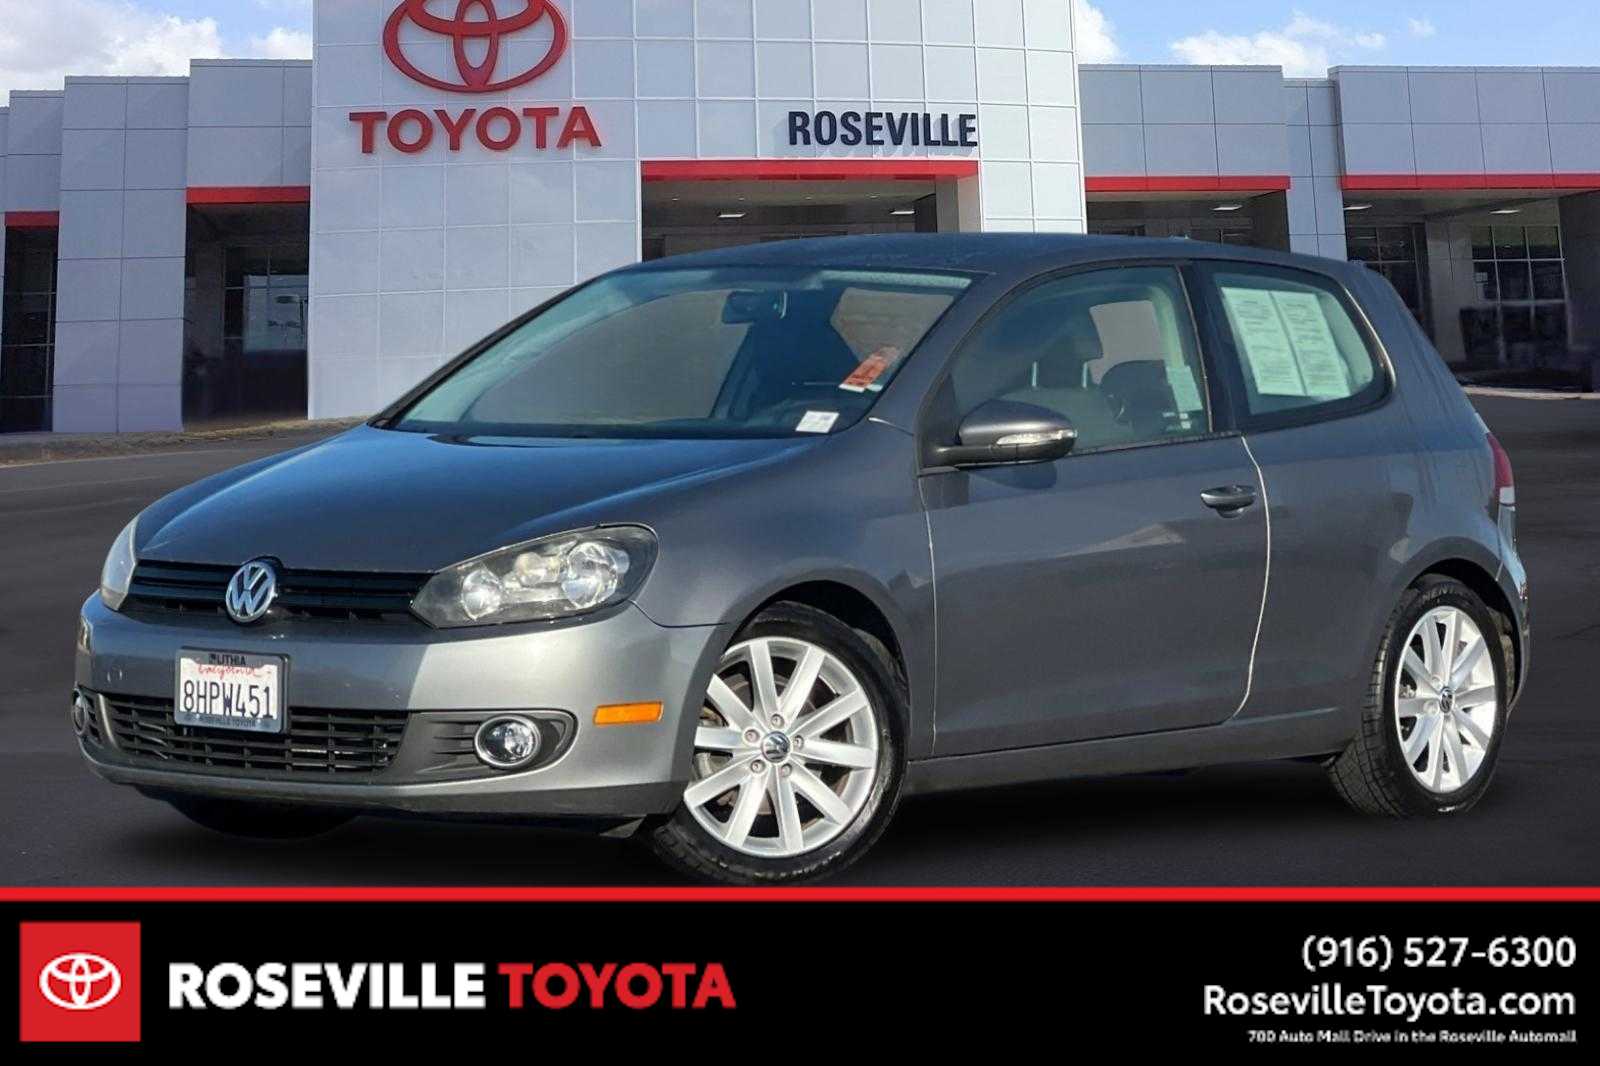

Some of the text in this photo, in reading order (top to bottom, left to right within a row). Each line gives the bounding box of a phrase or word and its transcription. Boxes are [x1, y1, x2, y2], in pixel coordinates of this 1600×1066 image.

[349, 107, 602, 153] TOYOTA
[788, 110, 978, 147] ROSEVILLE
[183, 680, 274, 718] 8HPW451
